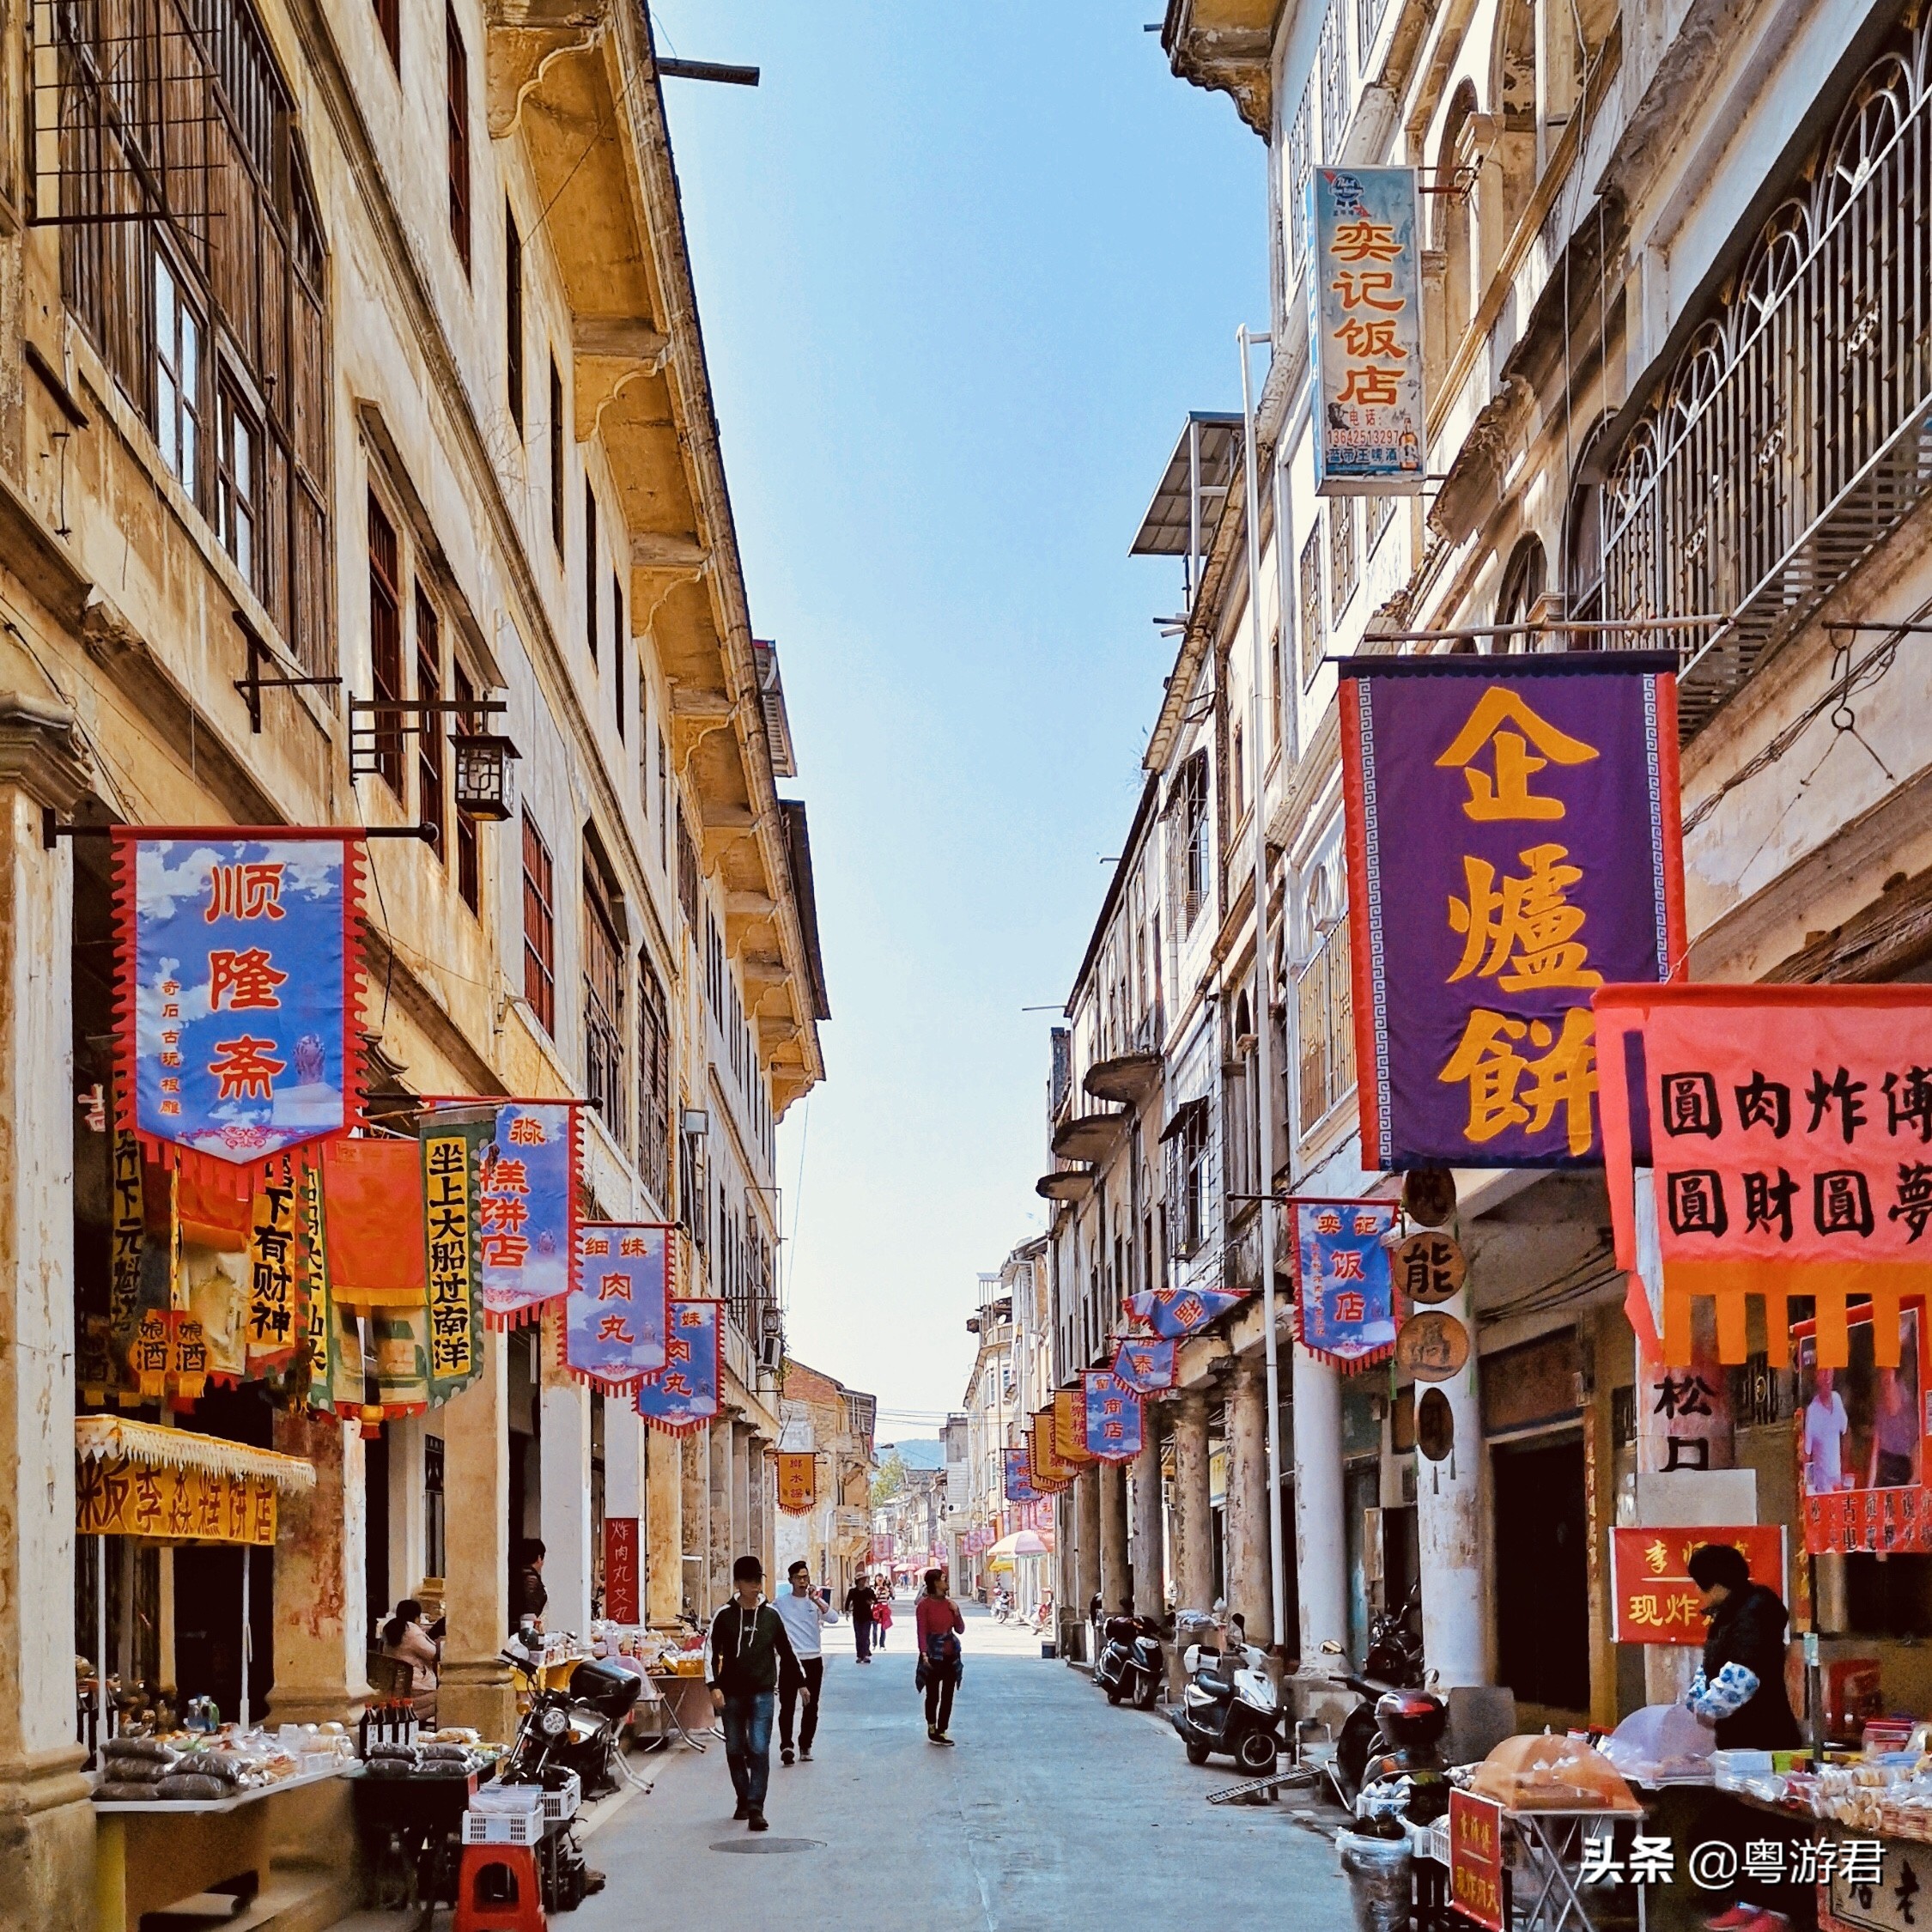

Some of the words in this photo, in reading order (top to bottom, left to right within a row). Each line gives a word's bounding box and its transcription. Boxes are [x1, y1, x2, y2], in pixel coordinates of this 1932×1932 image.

[1331, 222, 1407, 406] 奕记饭店
[1435, 686, 1603, 1157] 企爐餅
[205, 860, 288, 1101] 顺隆斋
[249, 1154, 295, 1343] 下有财神
[428, 1143, 469, 1370] 坐上大船过南洋
[585, 1236, 647, 1257] 细妹
[1403, 1242, 1453, 1294] 能
[598, 1272, 635, 1345] 肉丸
[1331, 1249, 1366, 1323] 饭店
[663, 1338, 694, 1397] 肉丸
[1103, 1398, 1124, 1438] 商店
